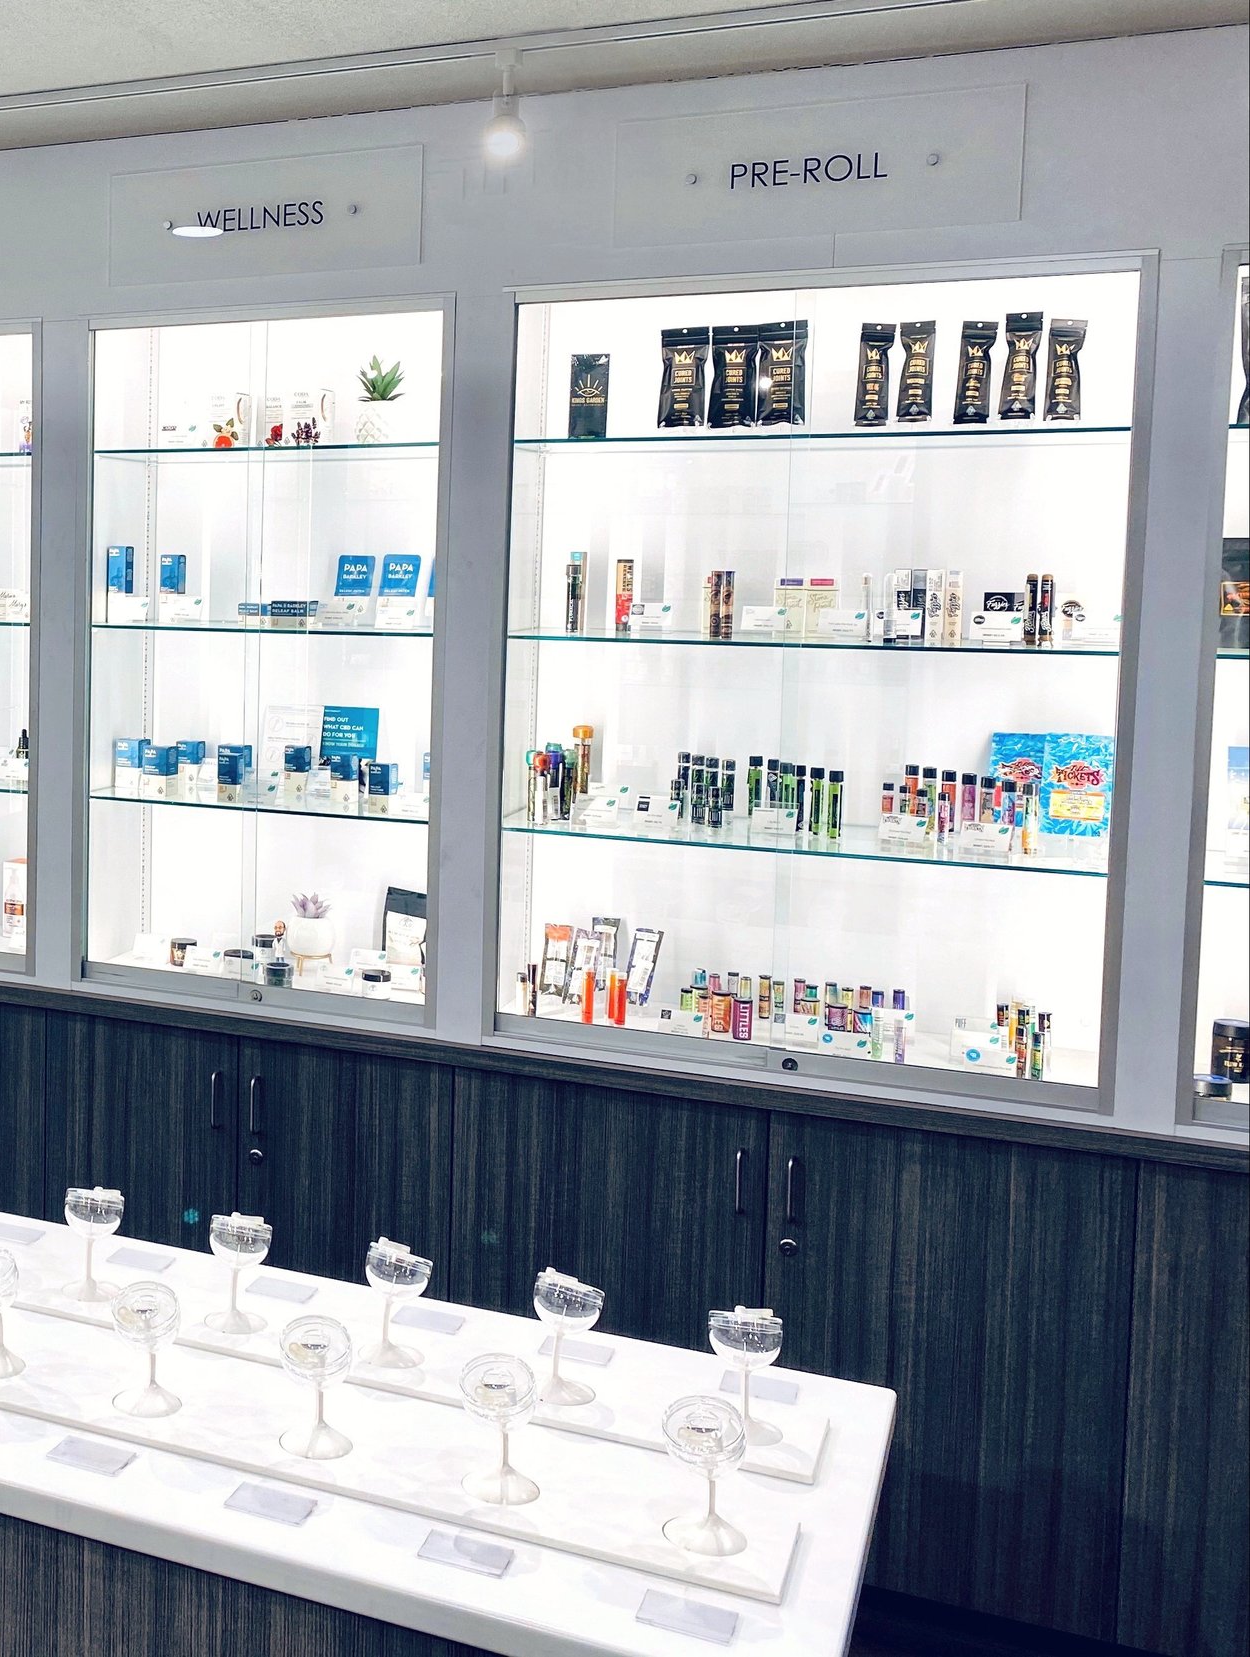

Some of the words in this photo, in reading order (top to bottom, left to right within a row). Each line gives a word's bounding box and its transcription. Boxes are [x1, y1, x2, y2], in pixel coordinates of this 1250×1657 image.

[730, 151, 889, 190] PRE-ROLL
[197, 200, 325, 233] WELLNESS
[772, 367, 791, 375] CURED
[673, 376, 693, 384] JOINTS
[772, 374, 791, 382] JOINTS
[343, 563, 368, 573] PAPA
[389, 562, 414, 573] PAPA
[1055, 766, 1101, 786] TICKETS
[739, 1003, 750, 1039] LITTLES
